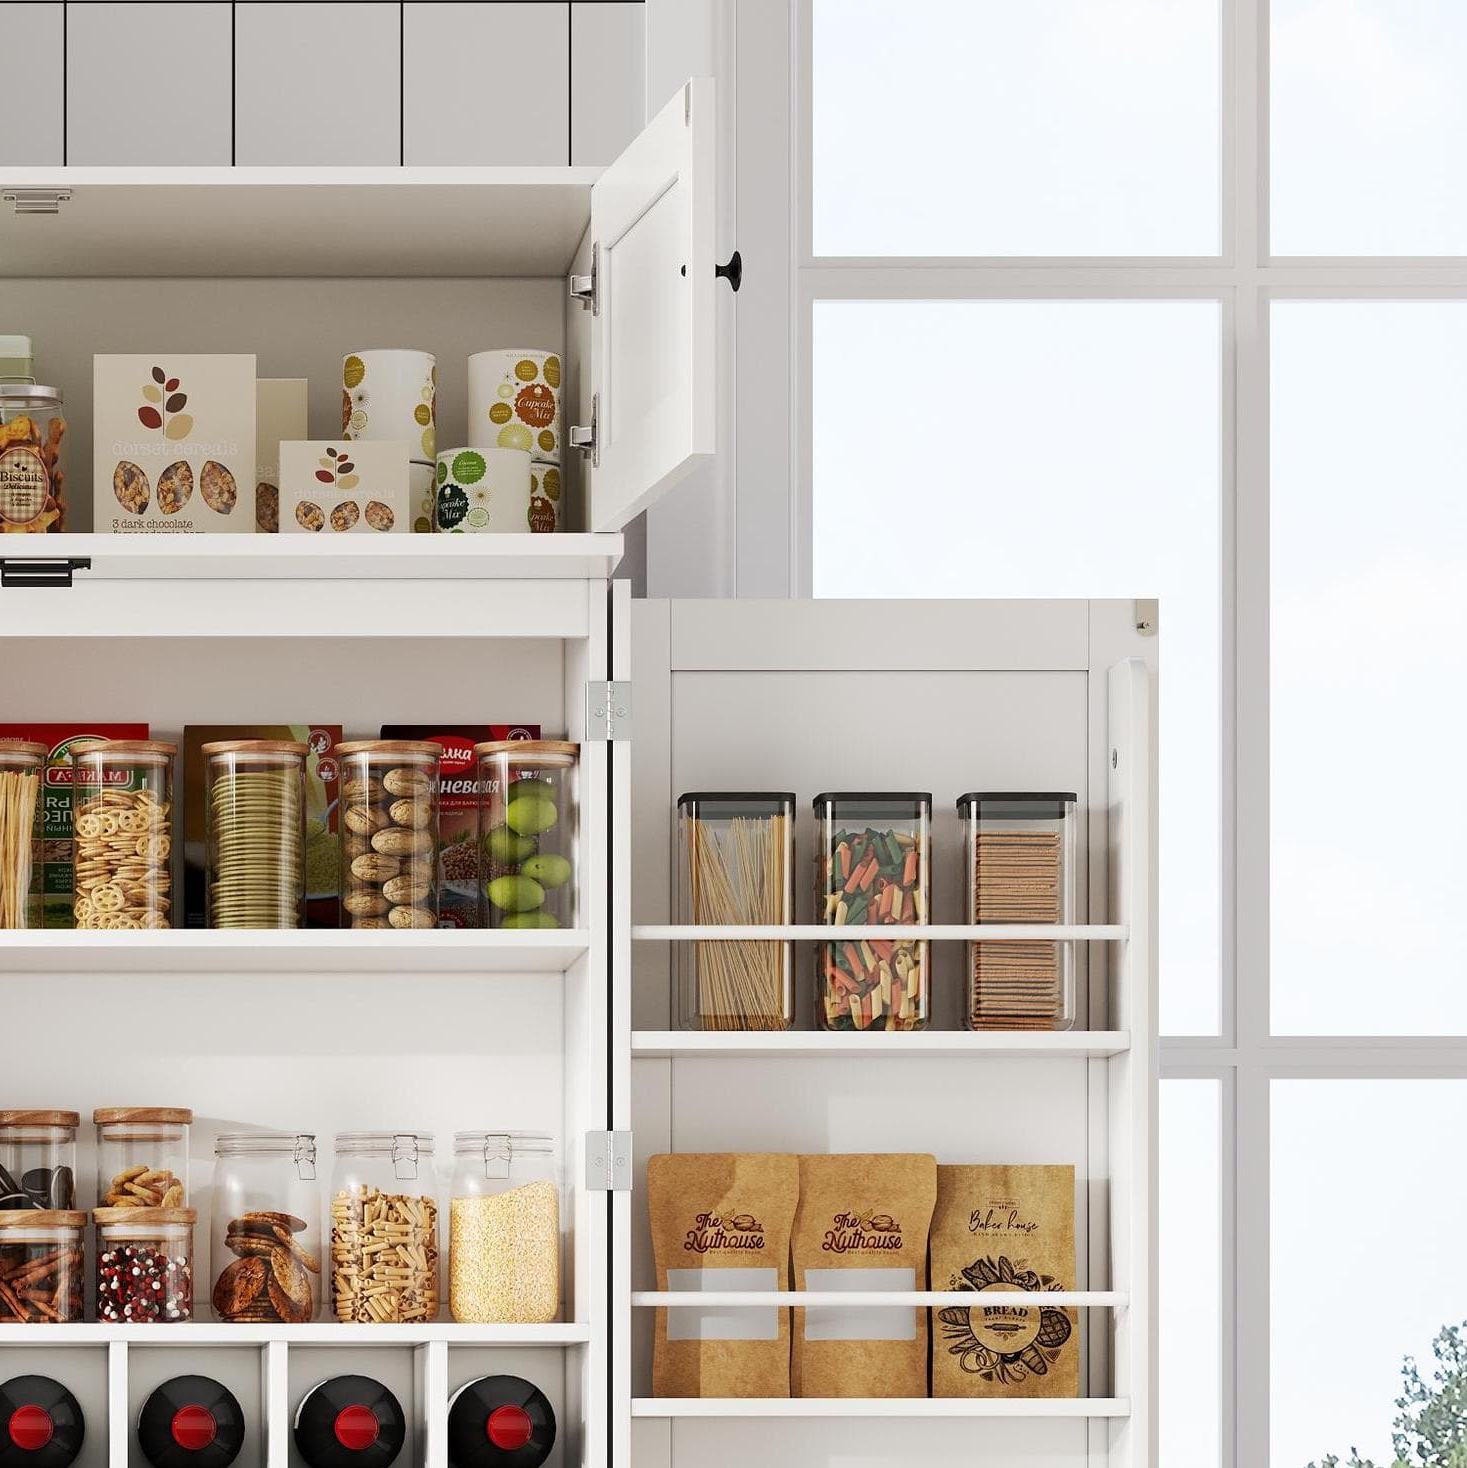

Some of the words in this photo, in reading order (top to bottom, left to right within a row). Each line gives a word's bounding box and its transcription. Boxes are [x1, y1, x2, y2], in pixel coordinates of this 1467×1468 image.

[518, 397, 553, 410] Cupcake
[0, 471, 43, 483] Biscuits
[112, 519, 119, 528] 3
[122, 519, 144, 528] dark
[146, 519, 193, 529] chocolate
[696, 1211, 722, 1231] The
[834, 1212, 860, 1232] The
[969, 1209, 1002, 1232] Baker
[1007, 1210, 1039, 1232] house
[684, 1228, 765, 1253] Nuthouse
[822, 1229, 903, 1253] Nuthouse
[983, 1306, 1028, 1317] BREAD
